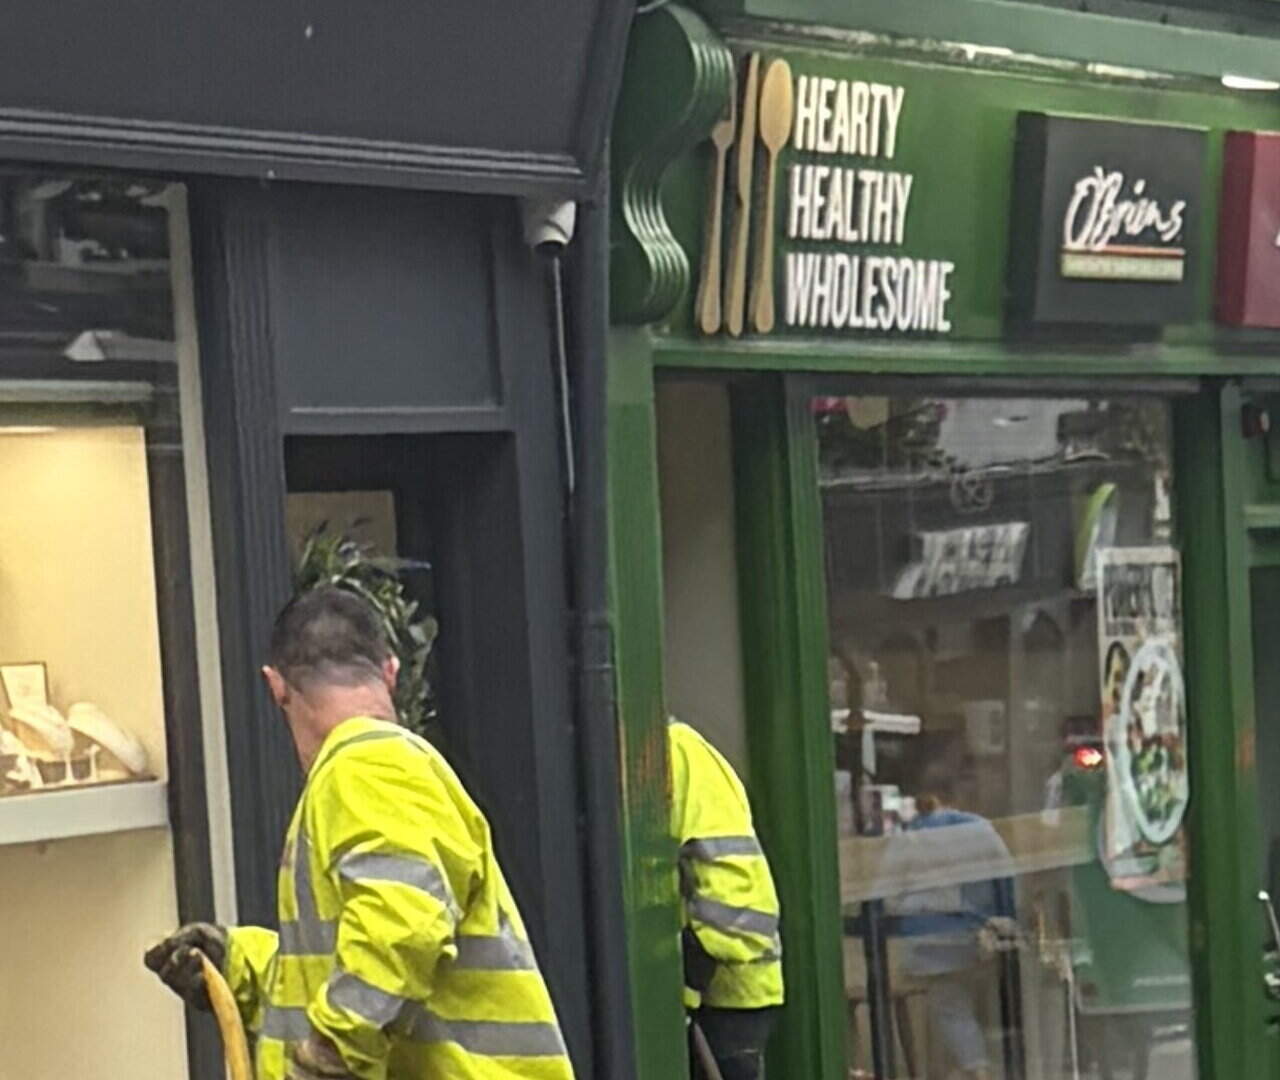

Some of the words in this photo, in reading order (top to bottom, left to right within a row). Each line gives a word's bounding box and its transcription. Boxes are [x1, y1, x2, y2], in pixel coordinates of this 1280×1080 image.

[794, 74, 905, 159] HEARTY
[789, 164, 913, 245] HEALTHY
[786, 252, 955, 332] WHOLESOME
